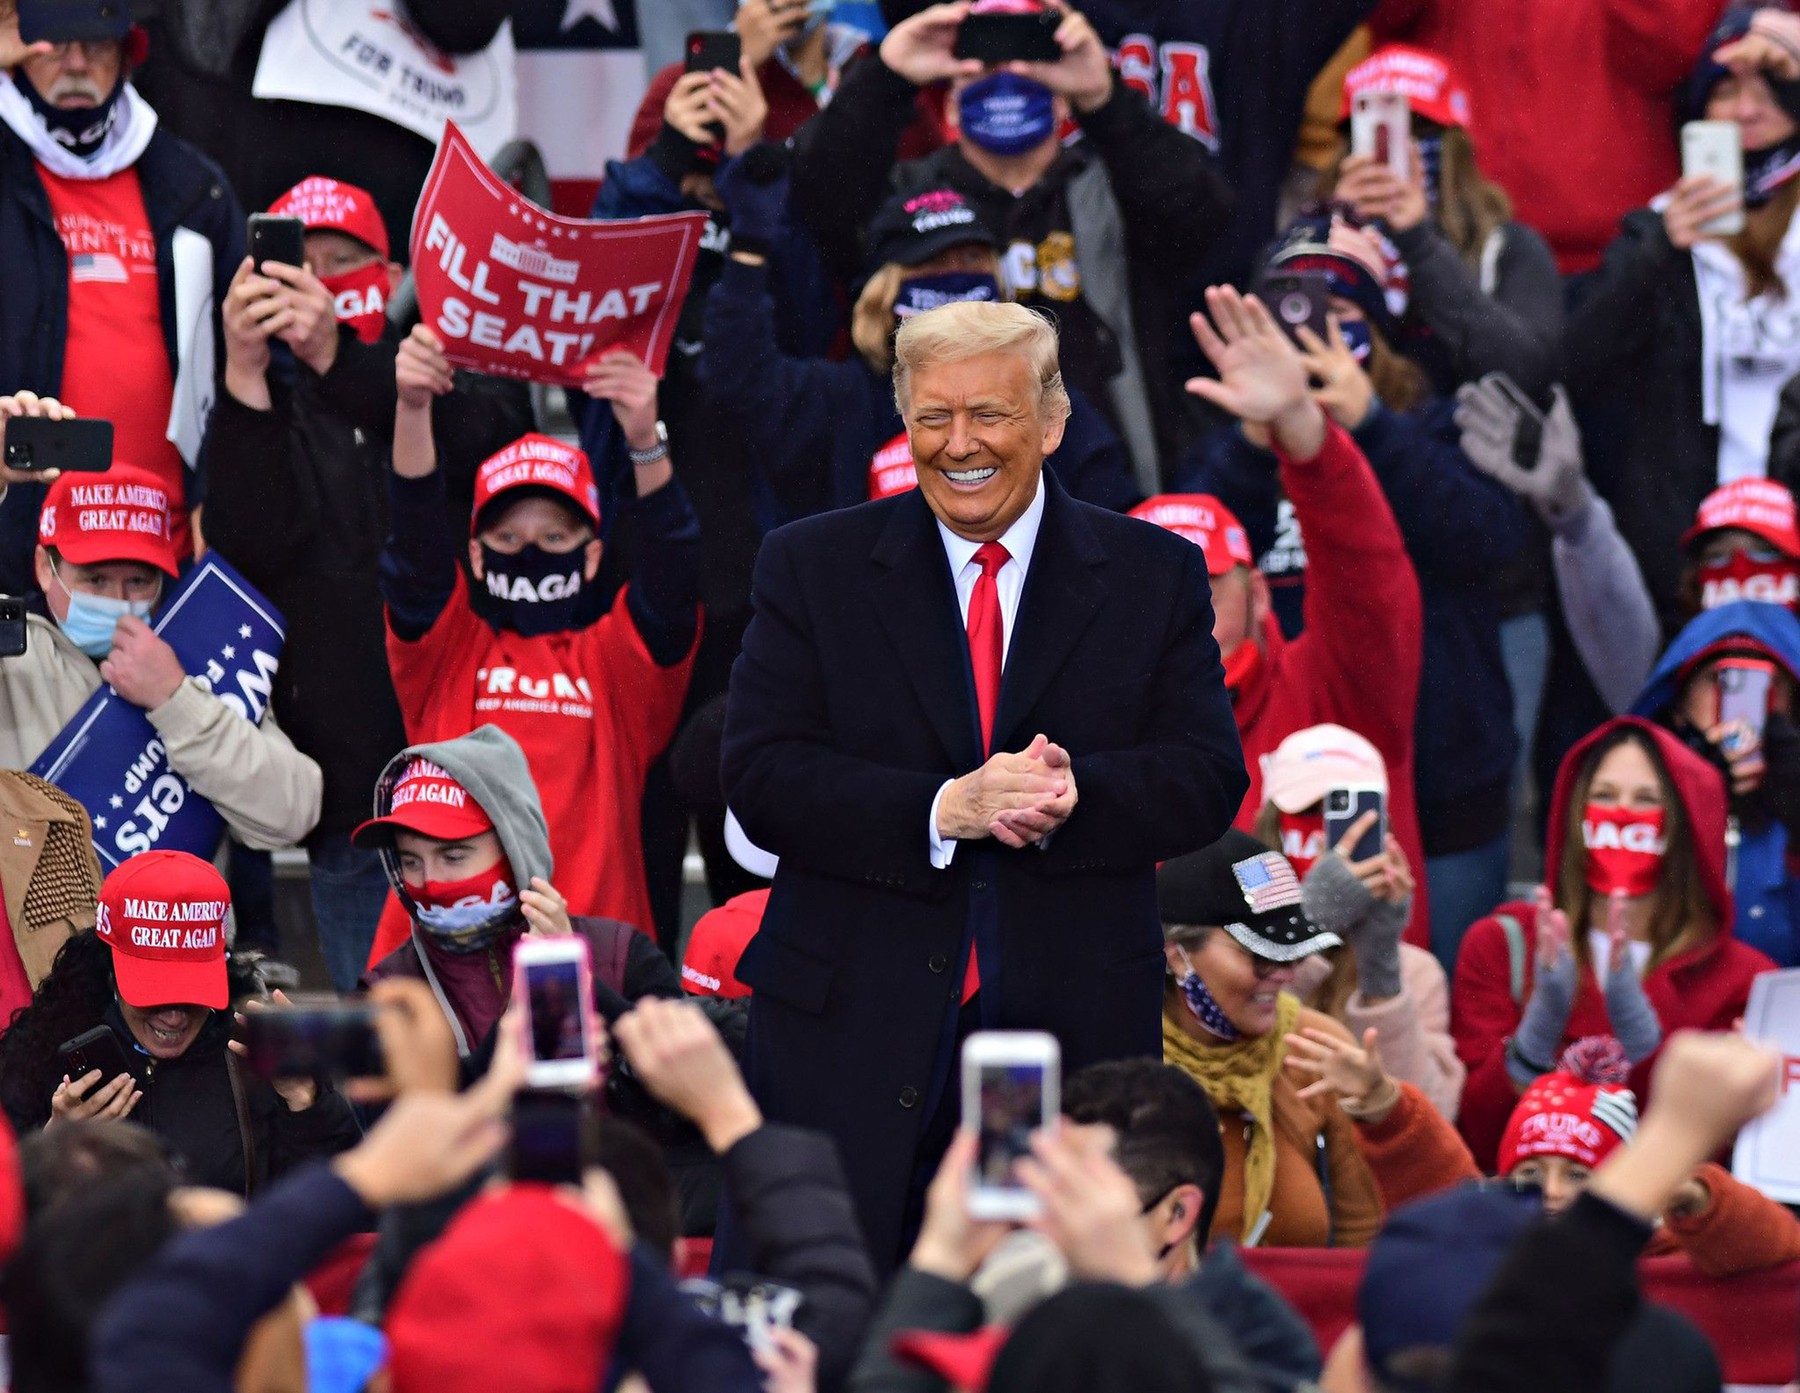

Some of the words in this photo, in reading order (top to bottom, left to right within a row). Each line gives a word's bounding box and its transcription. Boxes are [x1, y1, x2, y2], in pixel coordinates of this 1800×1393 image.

[342, 36, 393, 72] FOR
[1108, 34, 1220, 157] SA
[425, 211, 500, 305] FILL
[517, 280, 662, 325] THAT
[334, 284, 384, 319] GA
[486, 462, 530, 494] GREAT
[71, 484, 114, 507] MAKE
[41, 506, 57, 537] 45
[79, 509, 128, 531] GREAT
[486, 570, 581, 603] MAGA
[502, 699, 559, 714] AMERICA
[124, 738, 167, 794] UMP
[416, 783, 466, 809] AGAIN
[96, 901, 112, 935] 45
[124, 898, 168, 922] MAKE
[131, 926, 180, 948] GREAT
[1520, 1112, 1602, 1149] TRUMP
